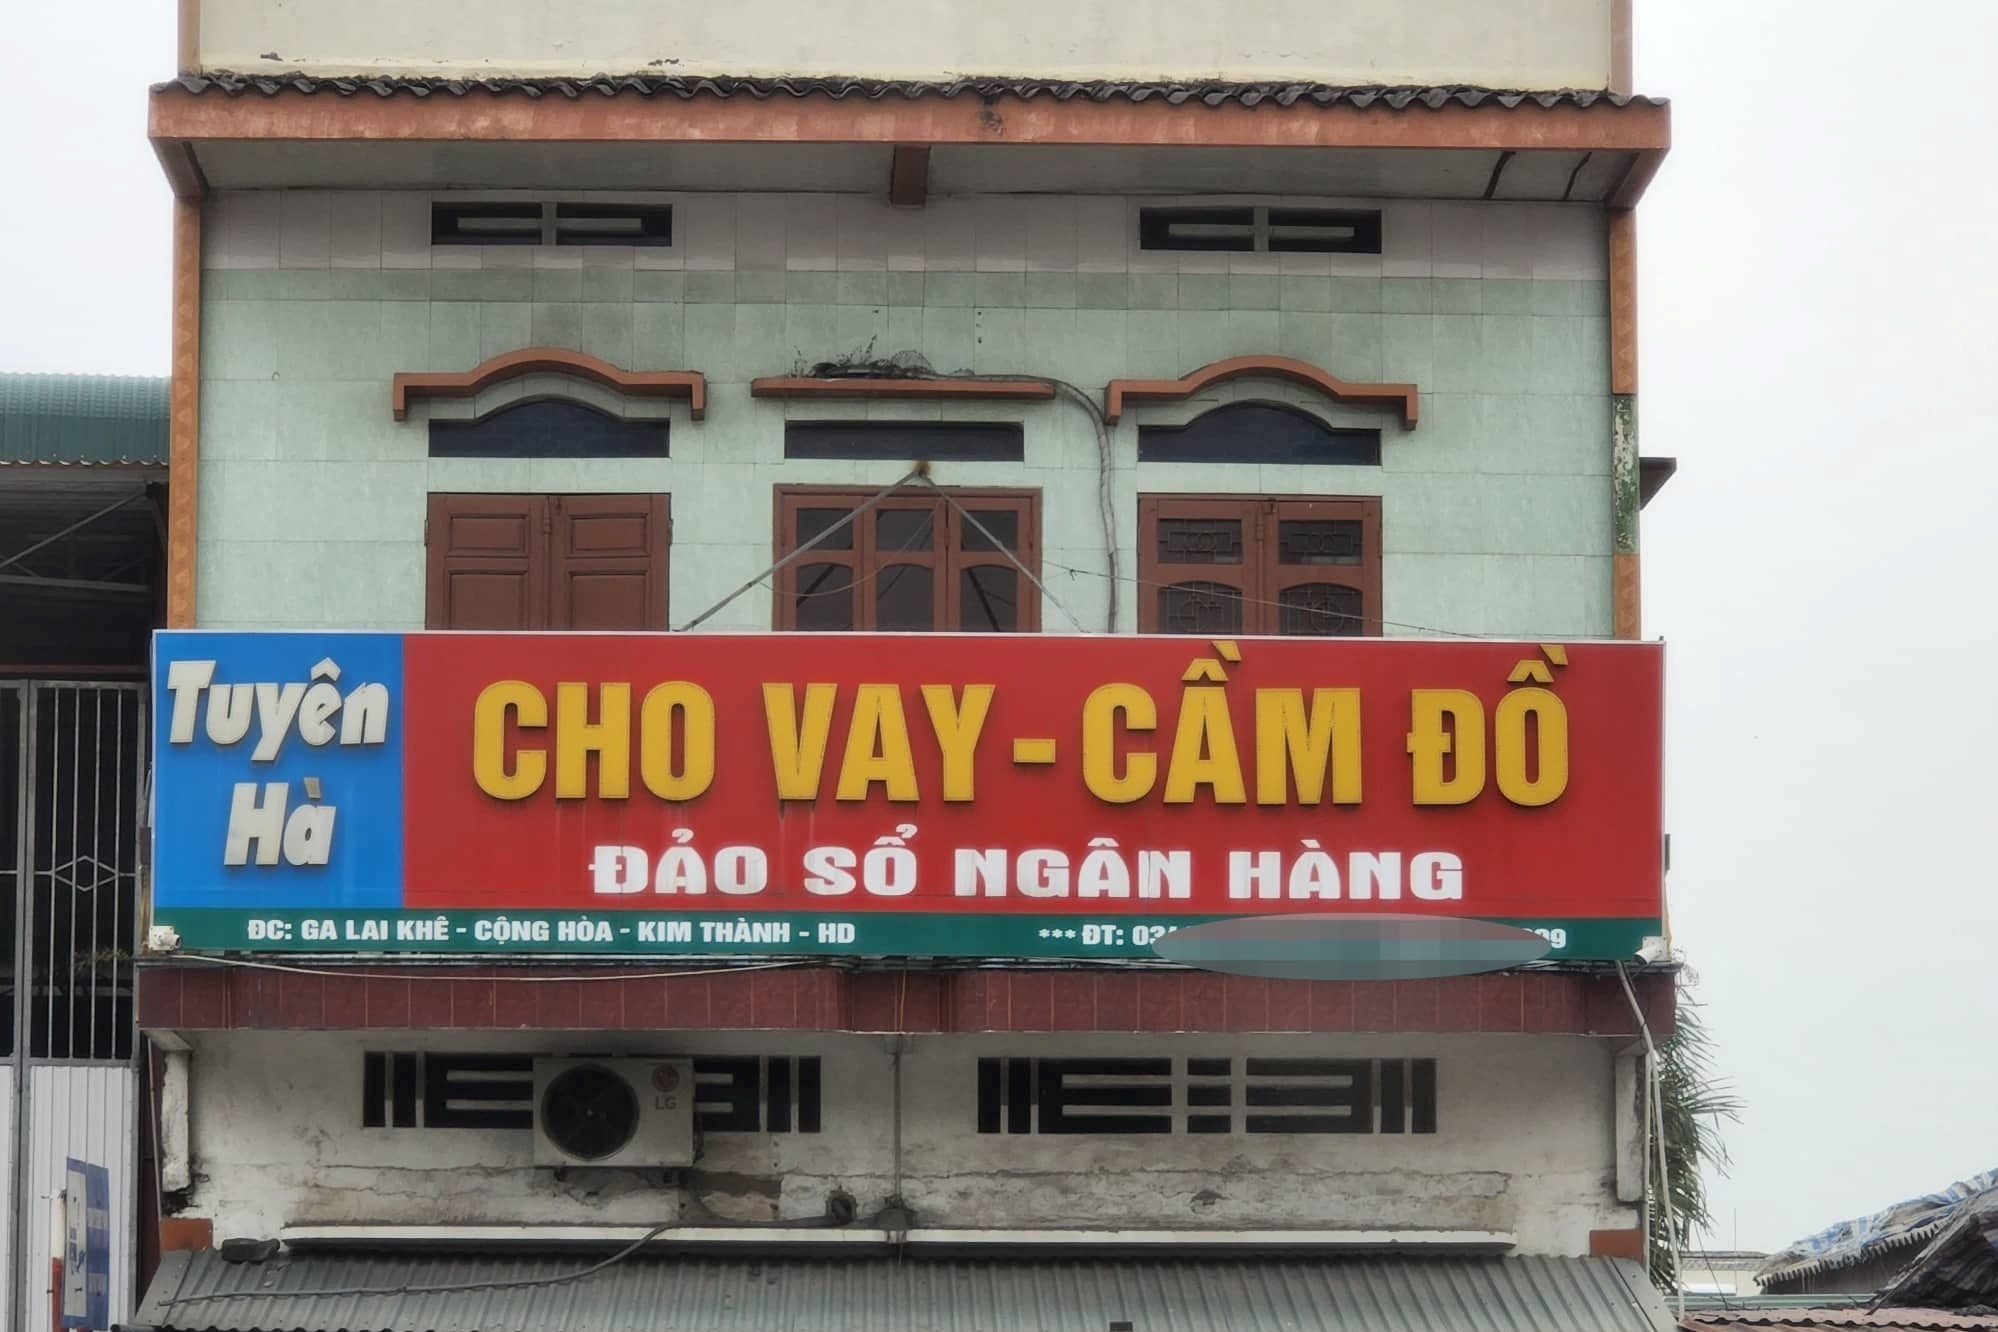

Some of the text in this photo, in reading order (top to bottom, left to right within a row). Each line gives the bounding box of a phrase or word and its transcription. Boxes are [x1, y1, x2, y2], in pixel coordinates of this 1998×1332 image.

[168, 657, 389, 760] Tuyên
[474, 640, 1569, 806] CHO VAY - CẦM ĐỒ
[223, 777, 337, 866] Hà
[588, 823, 1463, 901] ĐẢO SỔ NGÂN HÀNG
[248, 919, 293, 941] ĐC:
[301, 919, 338, 941] GA
[345, 919, 389, 941] LAI
[396, 915, 450, 941] KHÊ
[474, 916, 550, 945] CỘNG
[557, 916, 614, 942] HÒA
[637, 920, 692, 942] KIM
[699, 917, 791, 943] THÀNH
[818, 922, 856, 944] HD
[655, 1095, 677, 1110] LG
